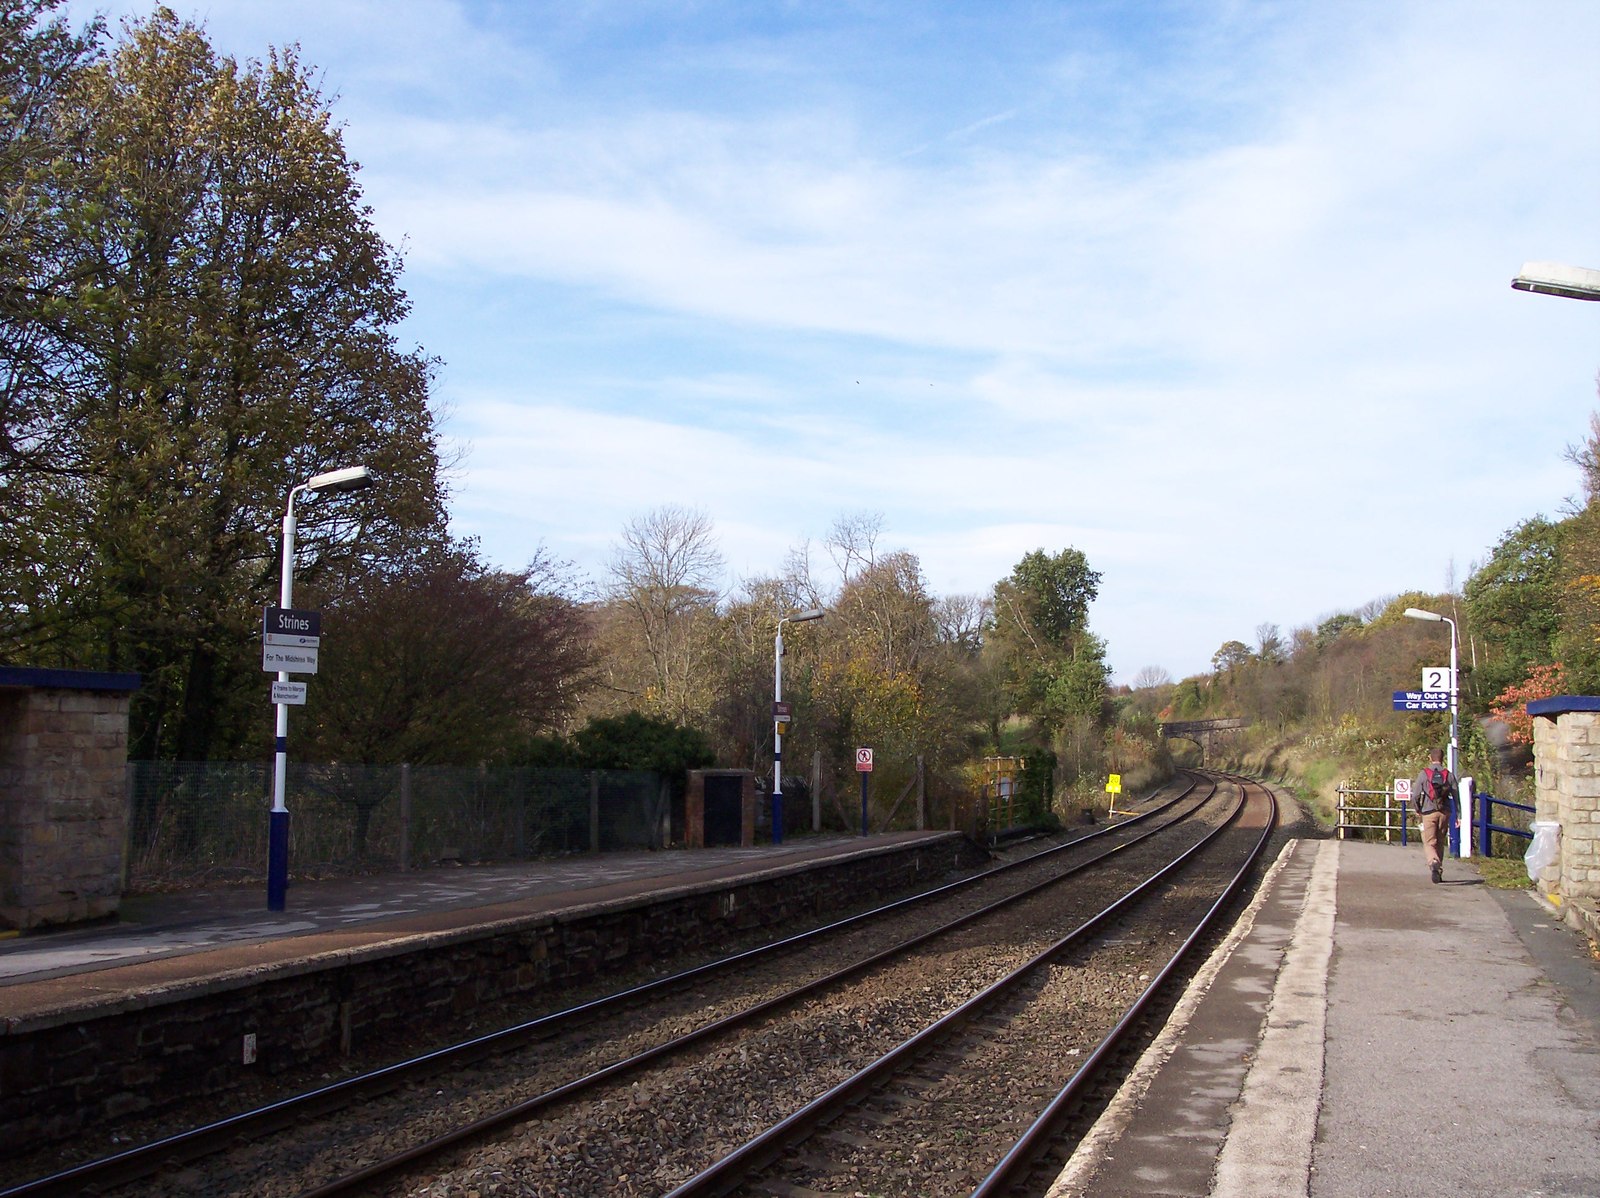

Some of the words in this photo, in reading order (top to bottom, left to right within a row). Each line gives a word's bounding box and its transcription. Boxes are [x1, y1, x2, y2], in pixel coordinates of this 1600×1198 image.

[279, 614, 309, 630] Strines
[266, 653, 274, 661] For
[275, 654, 284, 662] The
[1429, 672, 1441, 688] 2
[1406, 693, 1422, 701] Way
[1110, 776, 1118, 784] 20
